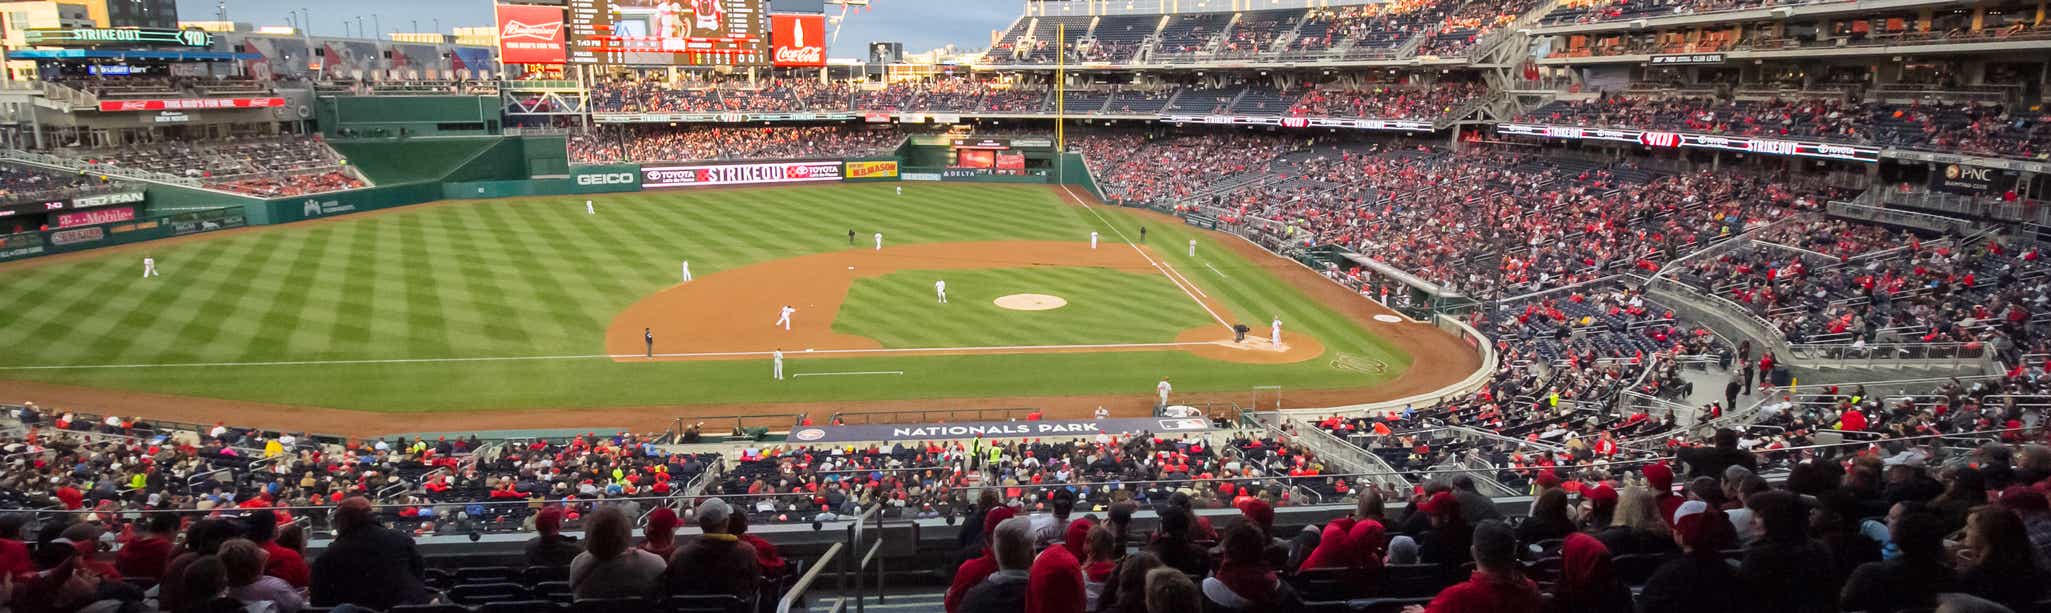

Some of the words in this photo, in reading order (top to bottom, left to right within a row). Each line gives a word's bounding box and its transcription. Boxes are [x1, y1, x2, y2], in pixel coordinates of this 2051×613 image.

[73, 28, 142, 41] STRIKEOUT
[738, 54, 745, 63] 0
[748, 54, 755, 63] 0
[776, 45, 822, 63] Coca-Cola
[1546, 126, 1584, 139] STRIKEOUT
[1748, 139, 1797, 156] STRIKEOUT
[661, 171, 695, 180] TOYOTA
[709, 165, 788, 183] STRIKEOUT
[808, 166, 838, 175] TOYOTA
[1961, 168, 1992, 182] PNC
[577, 173, 633, 186] GEICO
[111, 192, 144, 205] FAN
[899, 423, 1031, 437] NATIONALS
[1038, 421, 1099, 433] PARK
